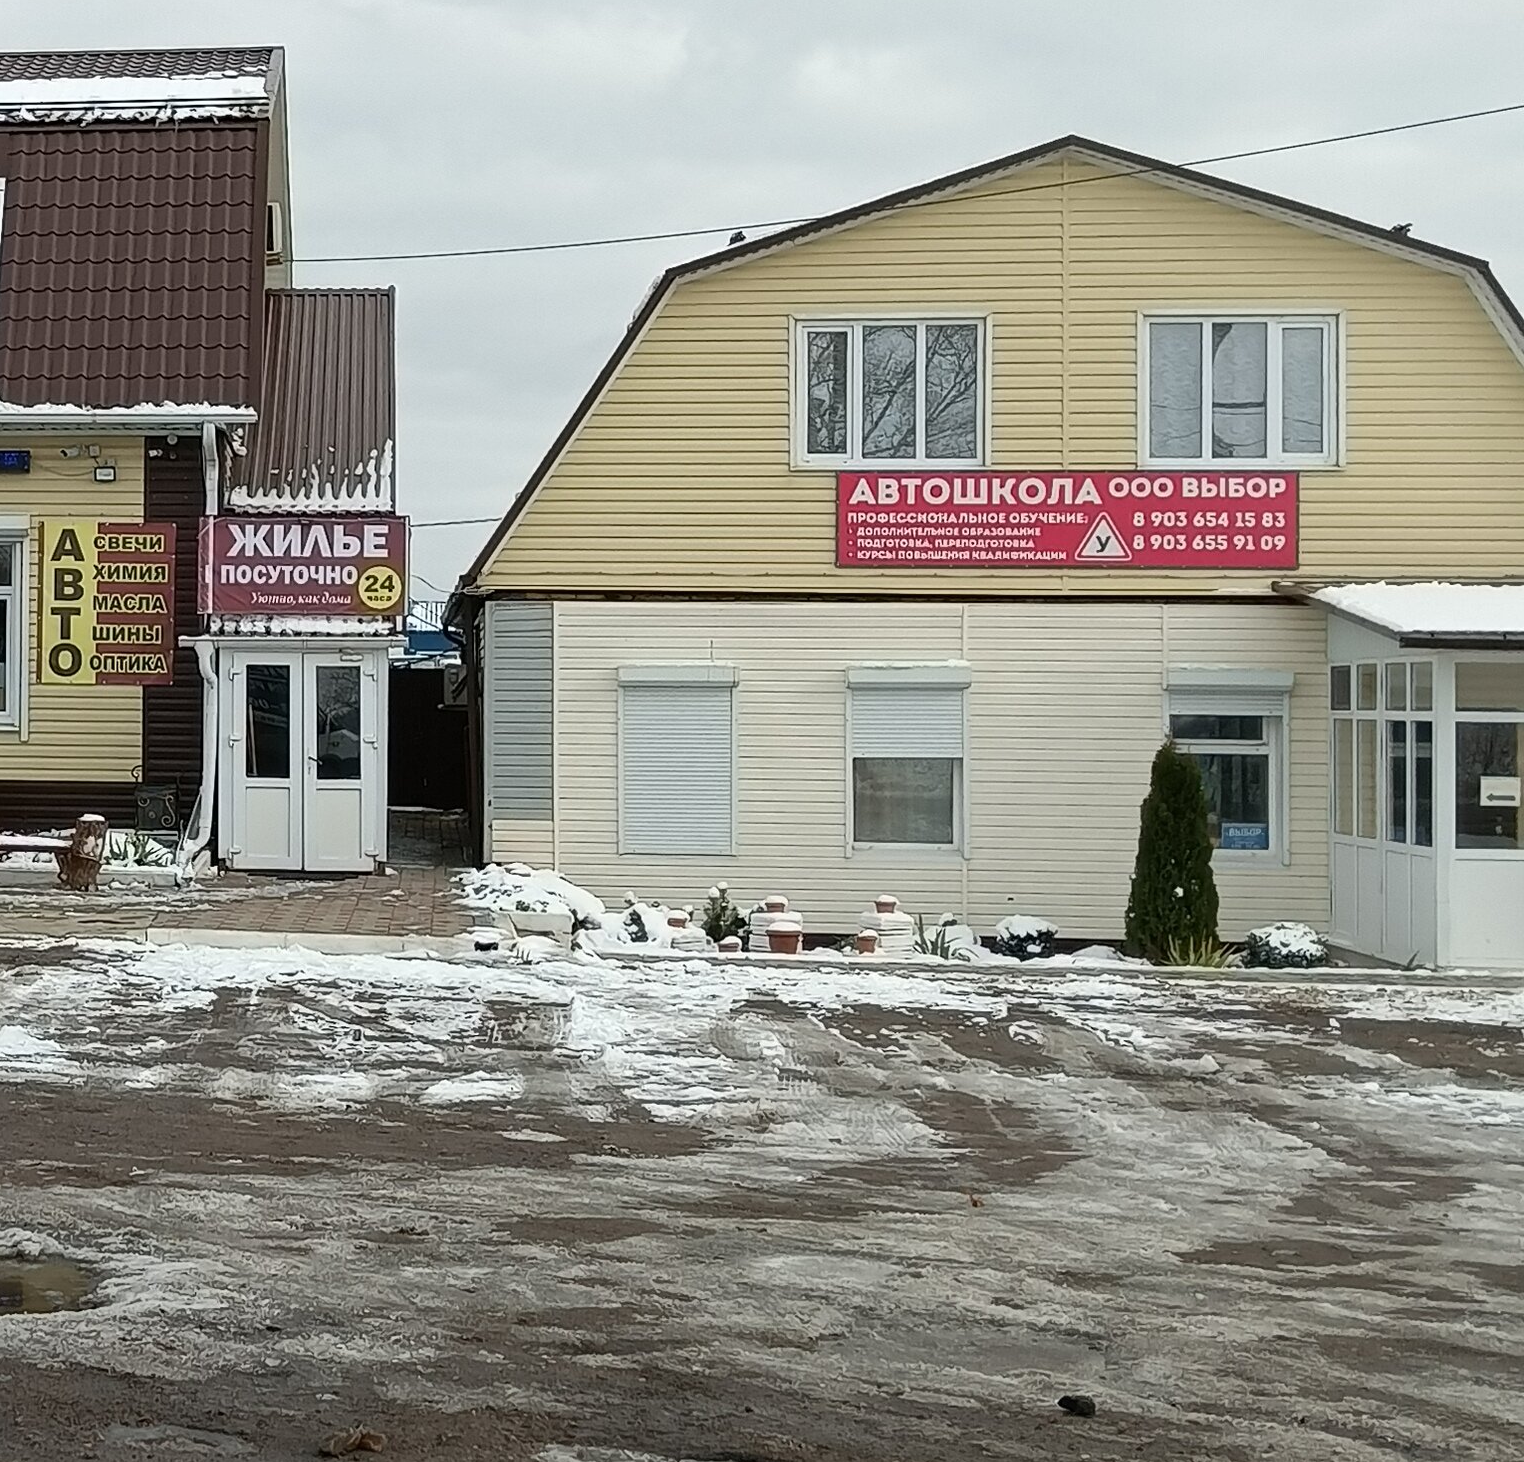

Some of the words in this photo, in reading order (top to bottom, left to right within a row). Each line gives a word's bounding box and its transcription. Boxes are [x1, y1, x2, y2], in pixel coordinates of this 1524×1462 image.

[848, 477, 1103, 505] АВТОШКОЛА
[1108, 478, 1174, 498] ООО
[1182, 478, 1287, 498] ВЫБОР
[847, 512, 1006, 524] ПРОФЕССИОНАЛЬНОЕ
[1132, 511, 1145, 527] 8
[1150, 511, 1188, 527] 903
[1192, 511, 1229, 528] 654
[1235, 511, 1256, 528] 15
[1261, 511, 1286, 528] 83
[226, 523, 389, 558] ЖИЛЬЕ
[856, 526, 960, 537] ДОПОЛНИТЕЛЬНОЕ
[961, 526, 1041, 537] ОБРАЗОВАНИЕ
[93, 535, 164, 553] СВЕЧИ
[935, 539, 1035, 549] ПЕРЕПОДГОТОВКА
[1132, 534, 1145, 550] 8
[1149, 534, 1187, 550] 903
[1192, 534, 1228, 551] 655
[1233, 534, 1256, 551] 91
[1260, 534, 1286, 551] 09
[857, 551, 896, 560] КУРСЫ
[897, 551, 970, 560] ПОВЫШЕНИЯ
[971, 551, 1067, 561] КВАЛИФИКАЦИИ
[92, 564, 167, 582] ХИМИЯ
[220, 564, 359, 585] ПОСУТОЧНО
[363, 575, 395, 593] 24
[48, 528, 85, 678] АВТО
[92, 594, 166, 614] МАСЛА
[298, 594, 320, 605] как
[321, 591, 352, 605] дома
[366, 595, 393, 603] часа
[91, 625, 161, 644] ШИНЫ
[89, 653, 166, 674] ОПТИКА
